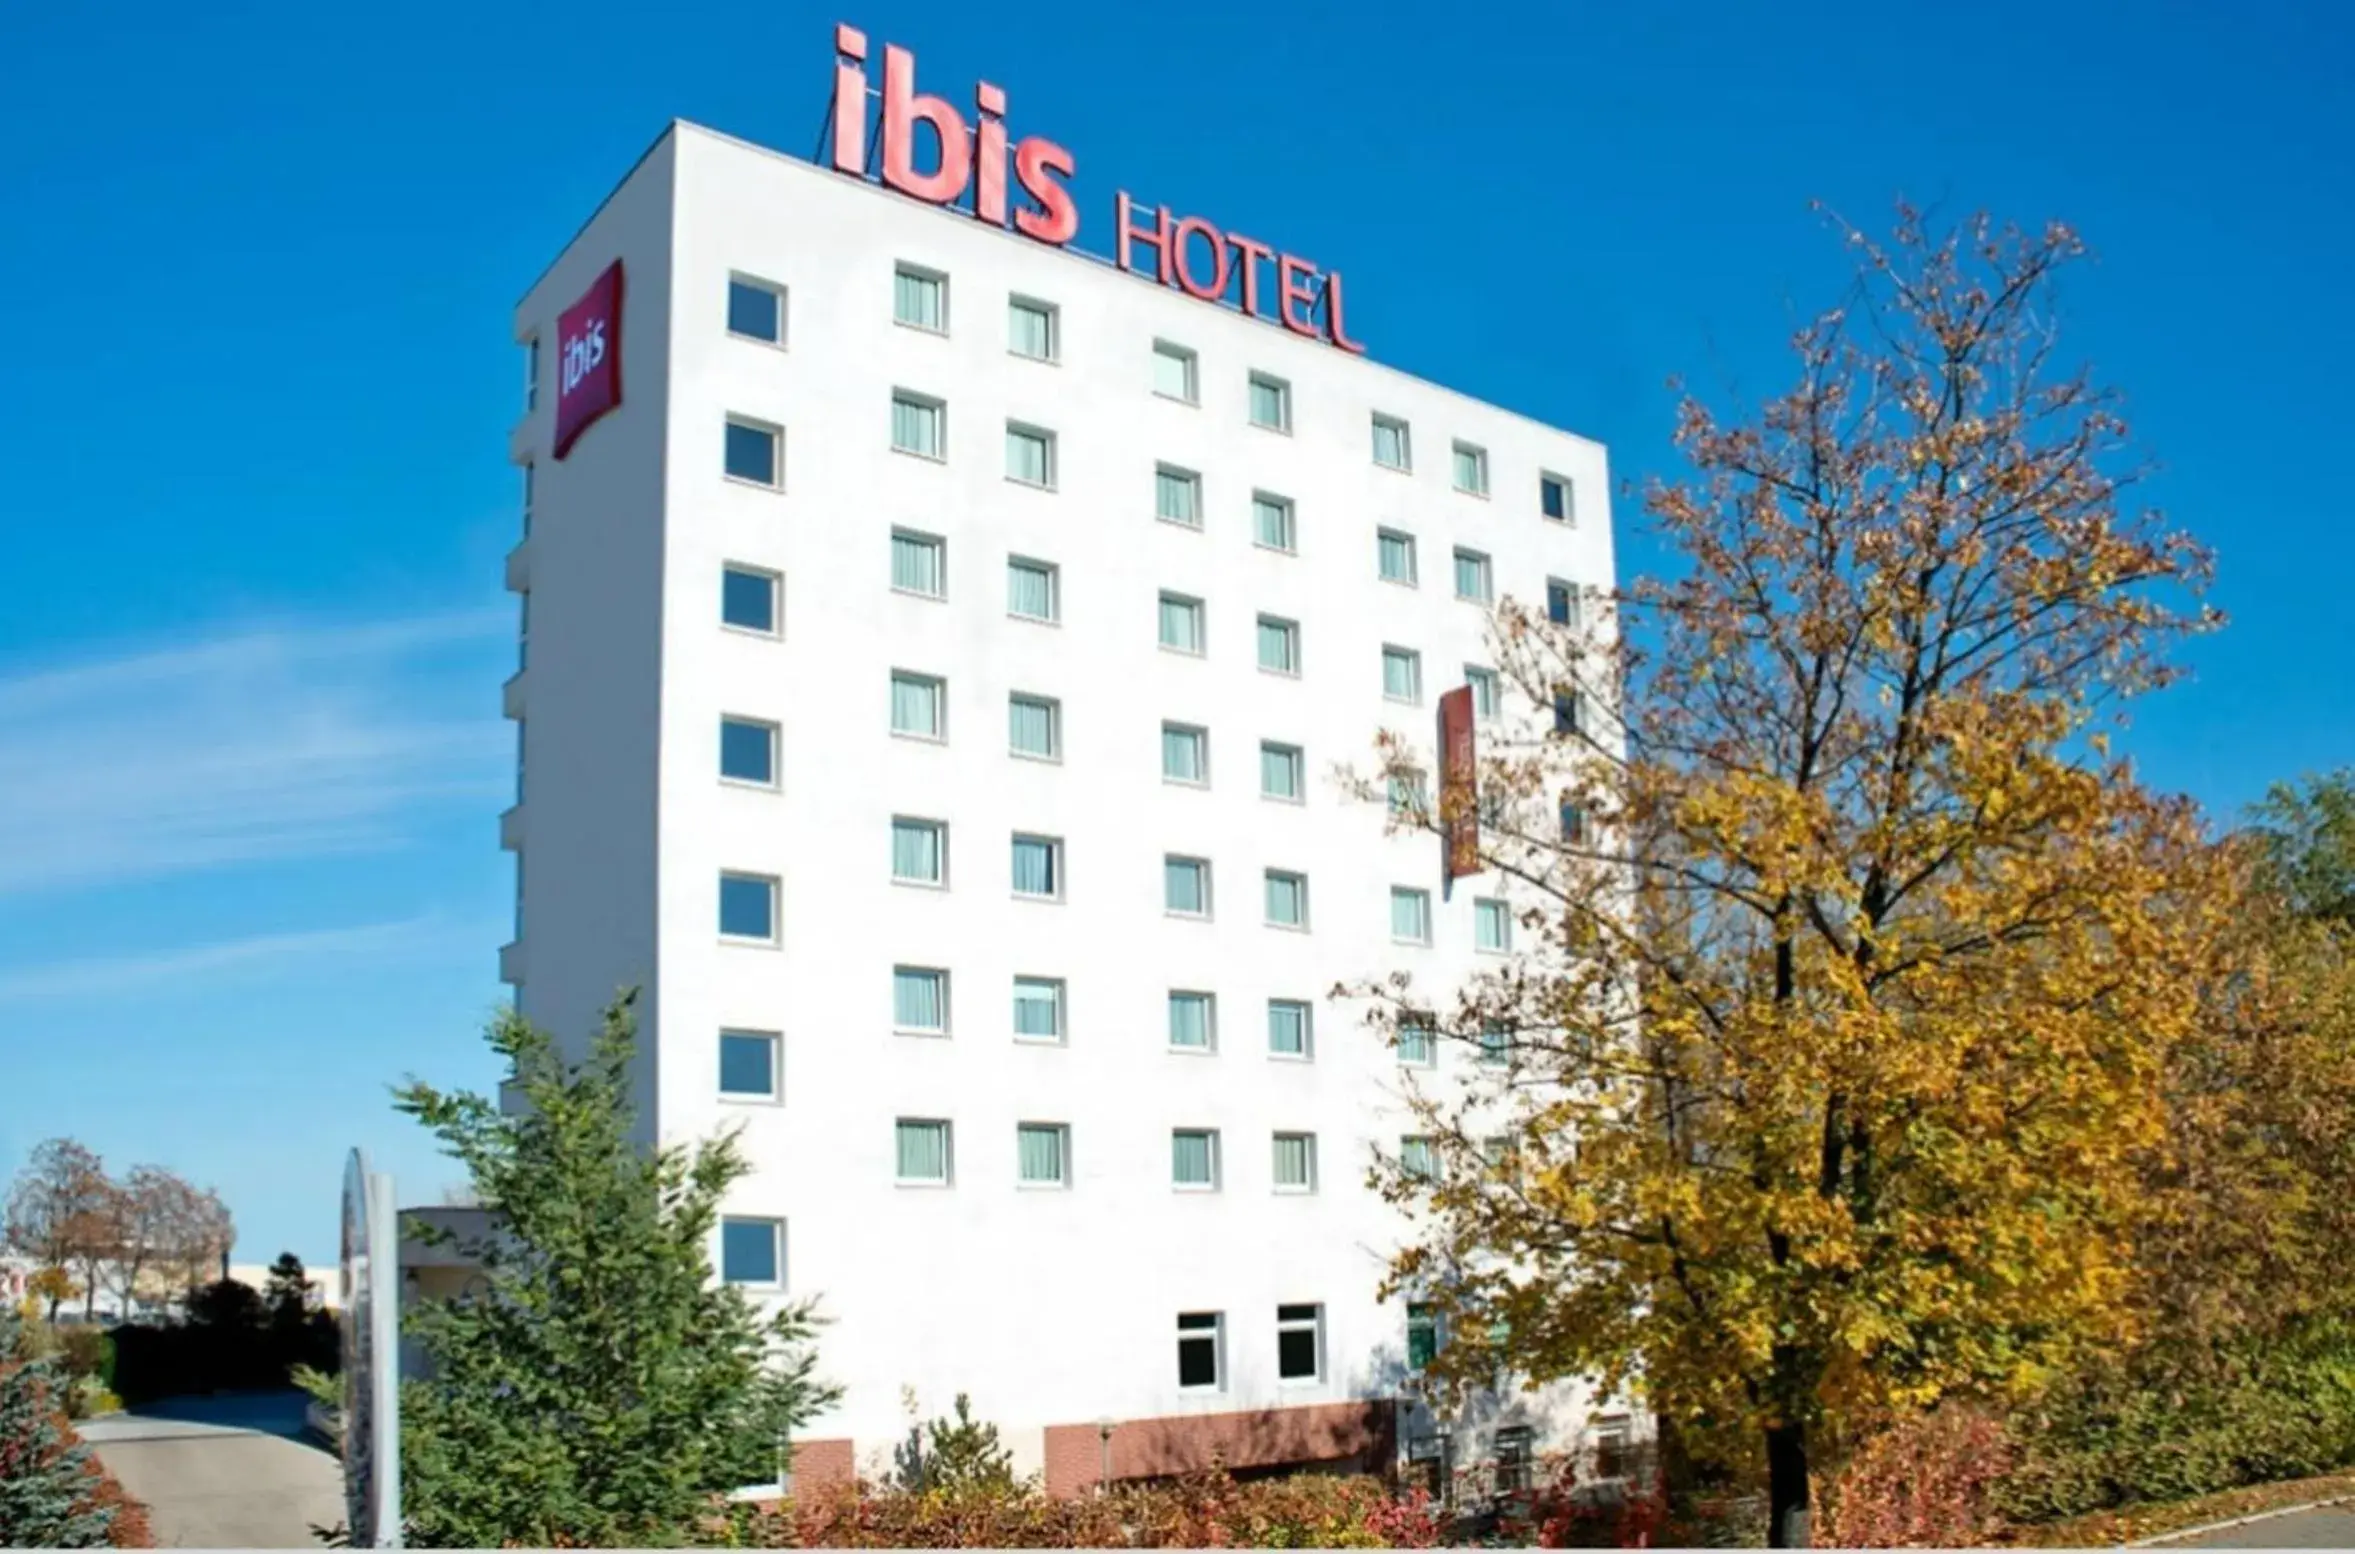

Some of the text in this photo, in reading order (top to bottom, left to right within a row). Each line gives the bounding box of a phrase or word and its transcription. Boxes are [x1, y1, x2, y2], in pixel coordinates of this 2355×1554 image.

[832, 22, 1366, 354] ibis HOTEL
[563, 318, 605, 396] ibis
